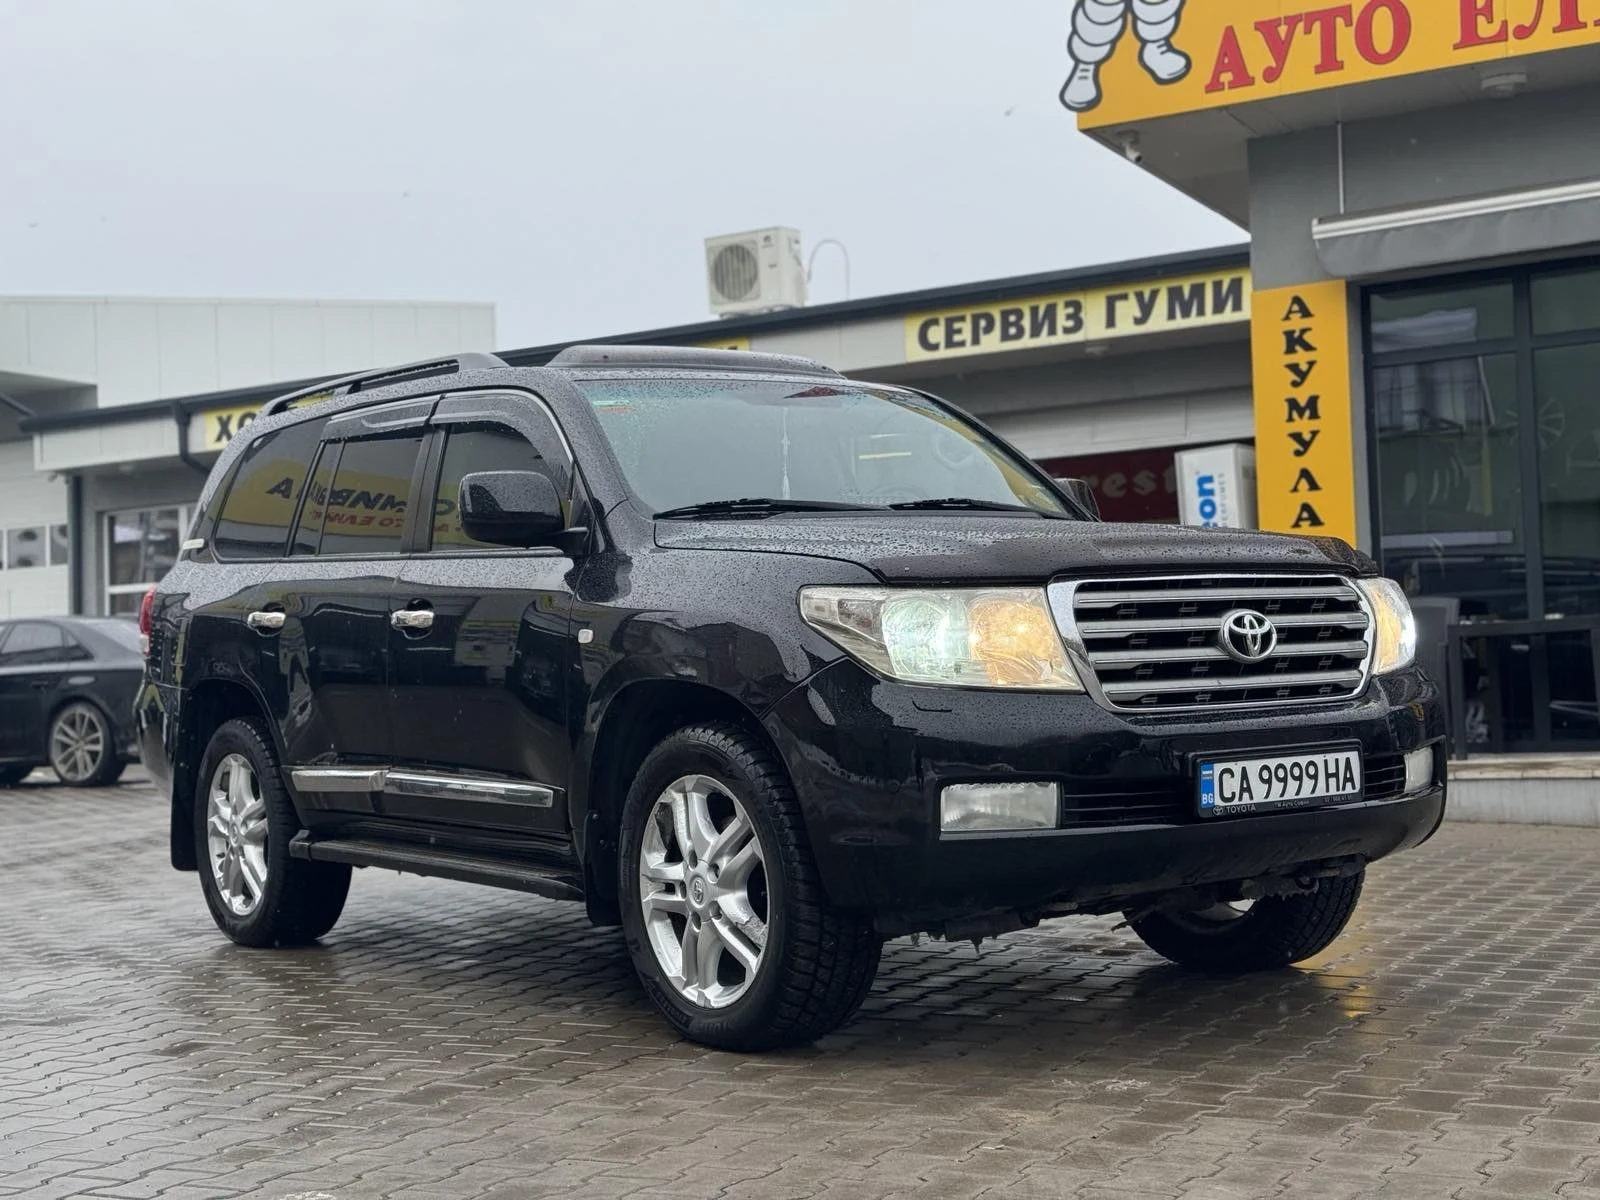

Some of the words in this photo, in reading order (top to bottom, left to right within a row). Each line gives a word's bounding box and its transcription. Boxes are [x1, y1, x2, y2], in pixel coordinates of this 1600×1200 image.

[1205, 0, 1412, 93] АУТО
[917, 299, 1084, 352] СЕРВИЗ
[1104, 276, 1244, 329] ГУМИ
[1281, 295, 1326, 528] АКУМУЛА
[1202, 793, 1214, 804] BG
[1218, 766, 1254, 803] CA
[1258, 760, 1319, 800] 9999
[1323, 757, 1357, 793] HA
[1226, 804, 1256, 814] TOYOTA
